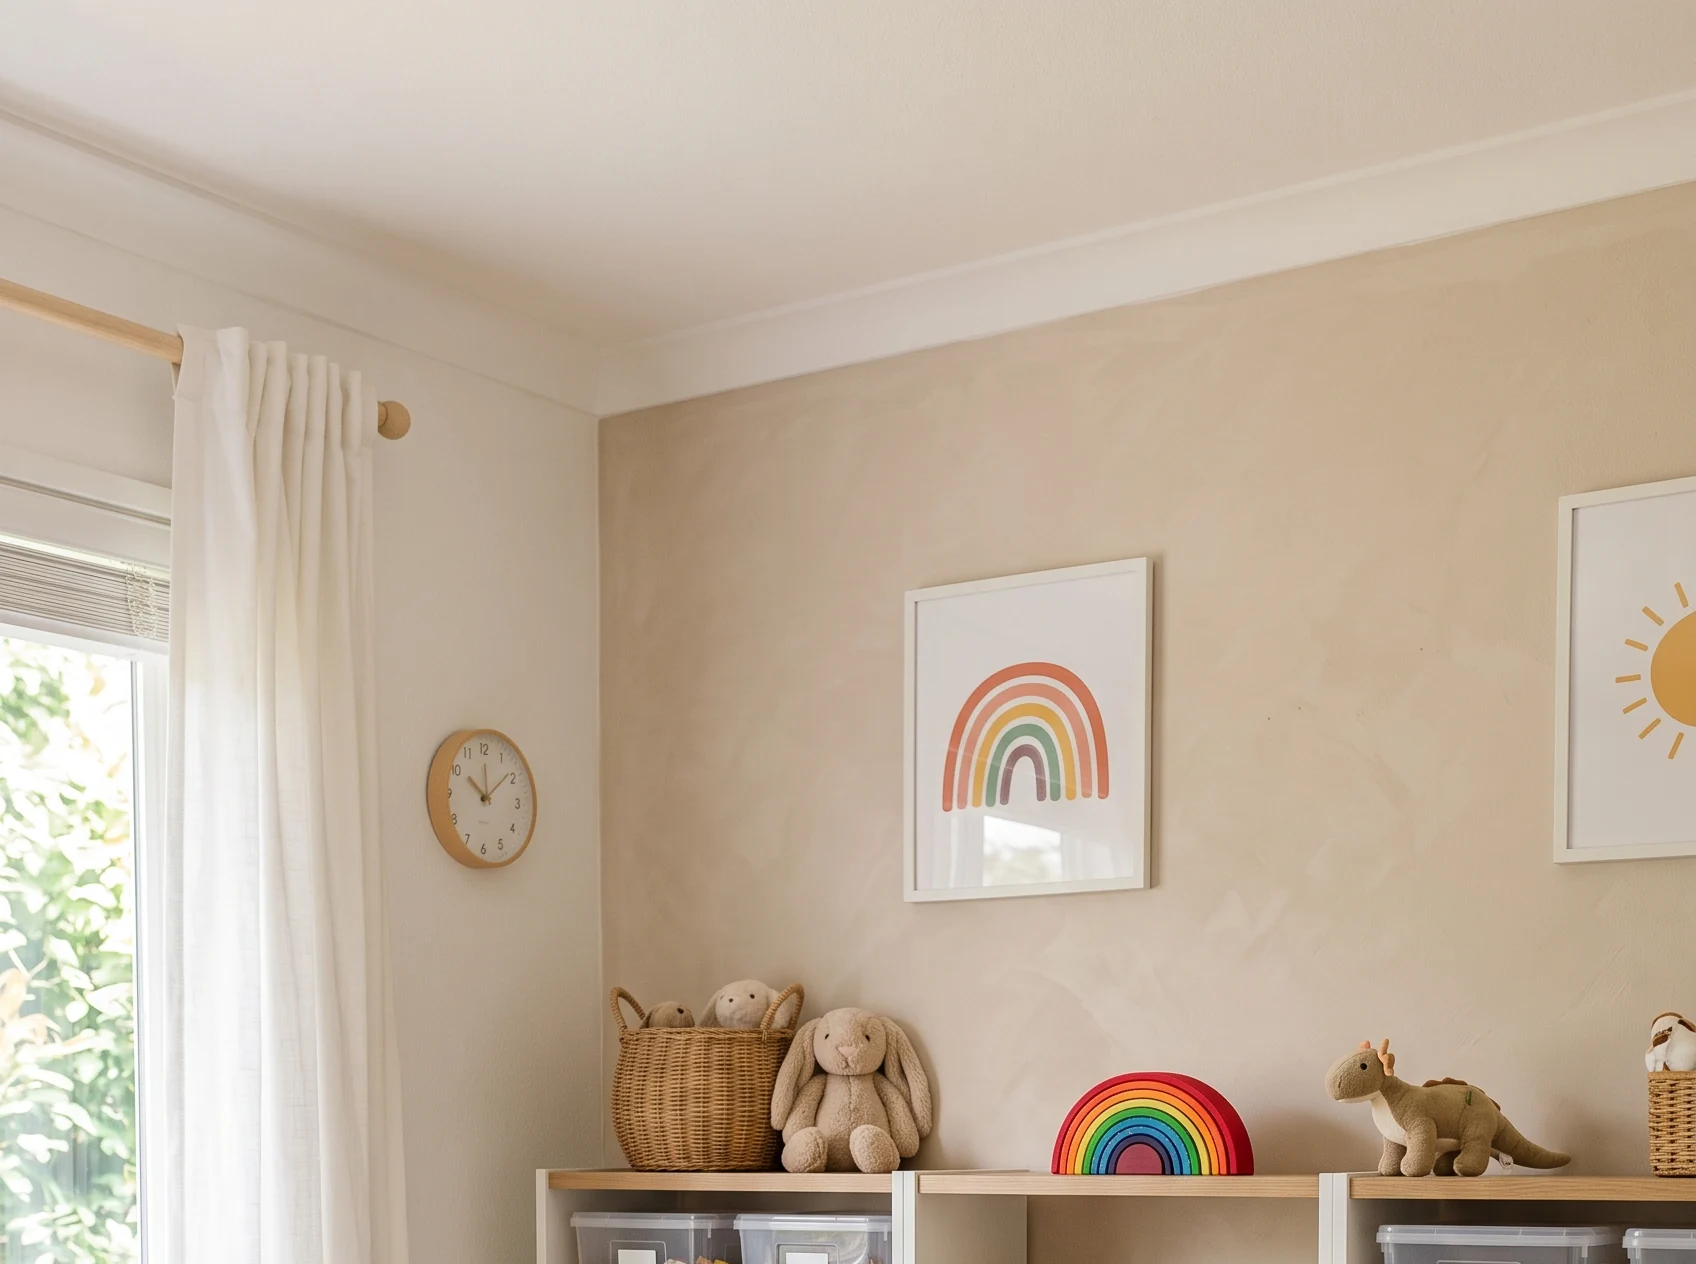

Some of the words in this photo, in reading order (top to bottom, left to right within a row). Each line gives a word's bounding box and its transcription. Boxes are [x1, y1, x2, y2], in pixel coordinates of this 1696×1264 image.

[463, 747, 472, 759] 11
[480, 743, 489, 755] 12
[451, 764, 461, 776] 10
[510, 773, 516, 784] 2
[515, 798, 521, 810] 3
[451, 813, 458, 825] 8
[510, 823, 515, 833] 4
[465, 834, 470, 845] 7
[497, 839, 504, 850] 5
[480, 844, 487, 855] 6
